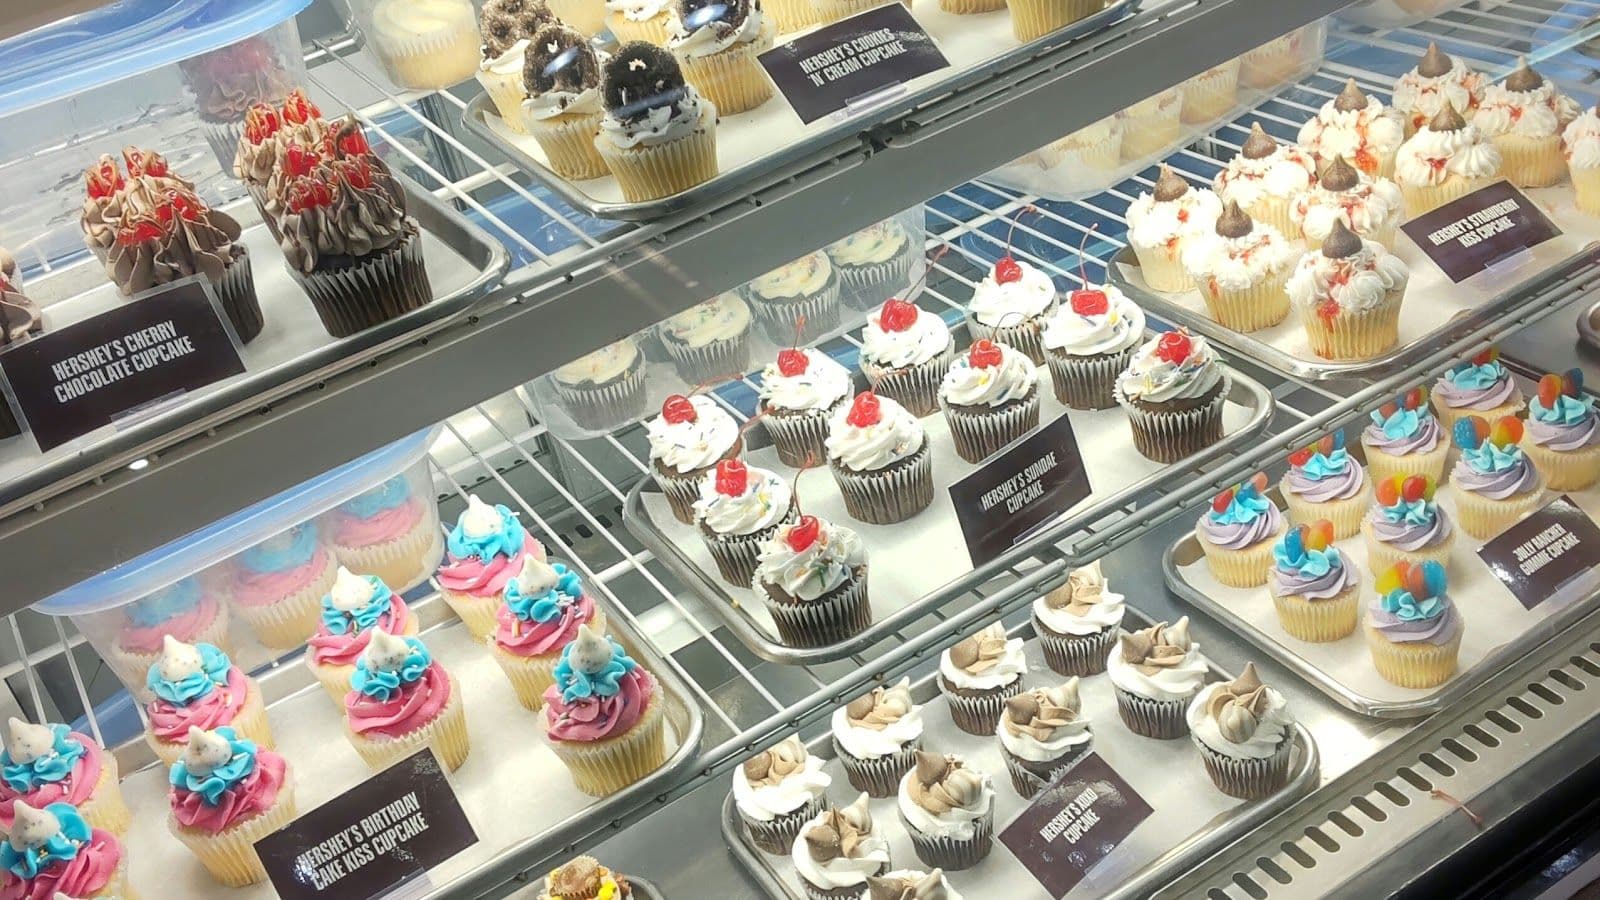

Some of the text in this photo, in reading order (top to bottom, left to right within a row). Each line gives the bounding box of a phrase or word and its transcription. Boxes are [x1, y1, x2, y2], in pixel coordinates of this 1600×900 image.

[799, 28, 896, 74] HERSHEY'S COOKIES
[825, 57, 863, 81] CREAM
[860, 41, 908, 66] CUPCAKE
[1427, 198, 1521, 246] HERSHEY'S STRAWBERRY
[1457, 215, 1516, 248] KISS CUPCAKE
[51, 320, 178, 381] HERSHEY'S CHERRY
[53, 335, 196, 403] CHOCOLATE CUPCAKE
[981, 451, 1058, 511] HERSHEY'S SUNDAE
[1006, 480, 1045, 514] CUPCAKE
[1512, 523, 1567, 562] JOLLY RANCHER
[1546, 532, 1581, 558] CUPCAKE
[297, 791, 421, 870] HERSHEY'S BIRTHDAY
[1039, 787, 1098, 843] HERSHEY'S XOXO
[1062, 809, 1101, 844] CUPCAKE
[311, 812, 429, 891] CAKE KISS CUPCAKE
